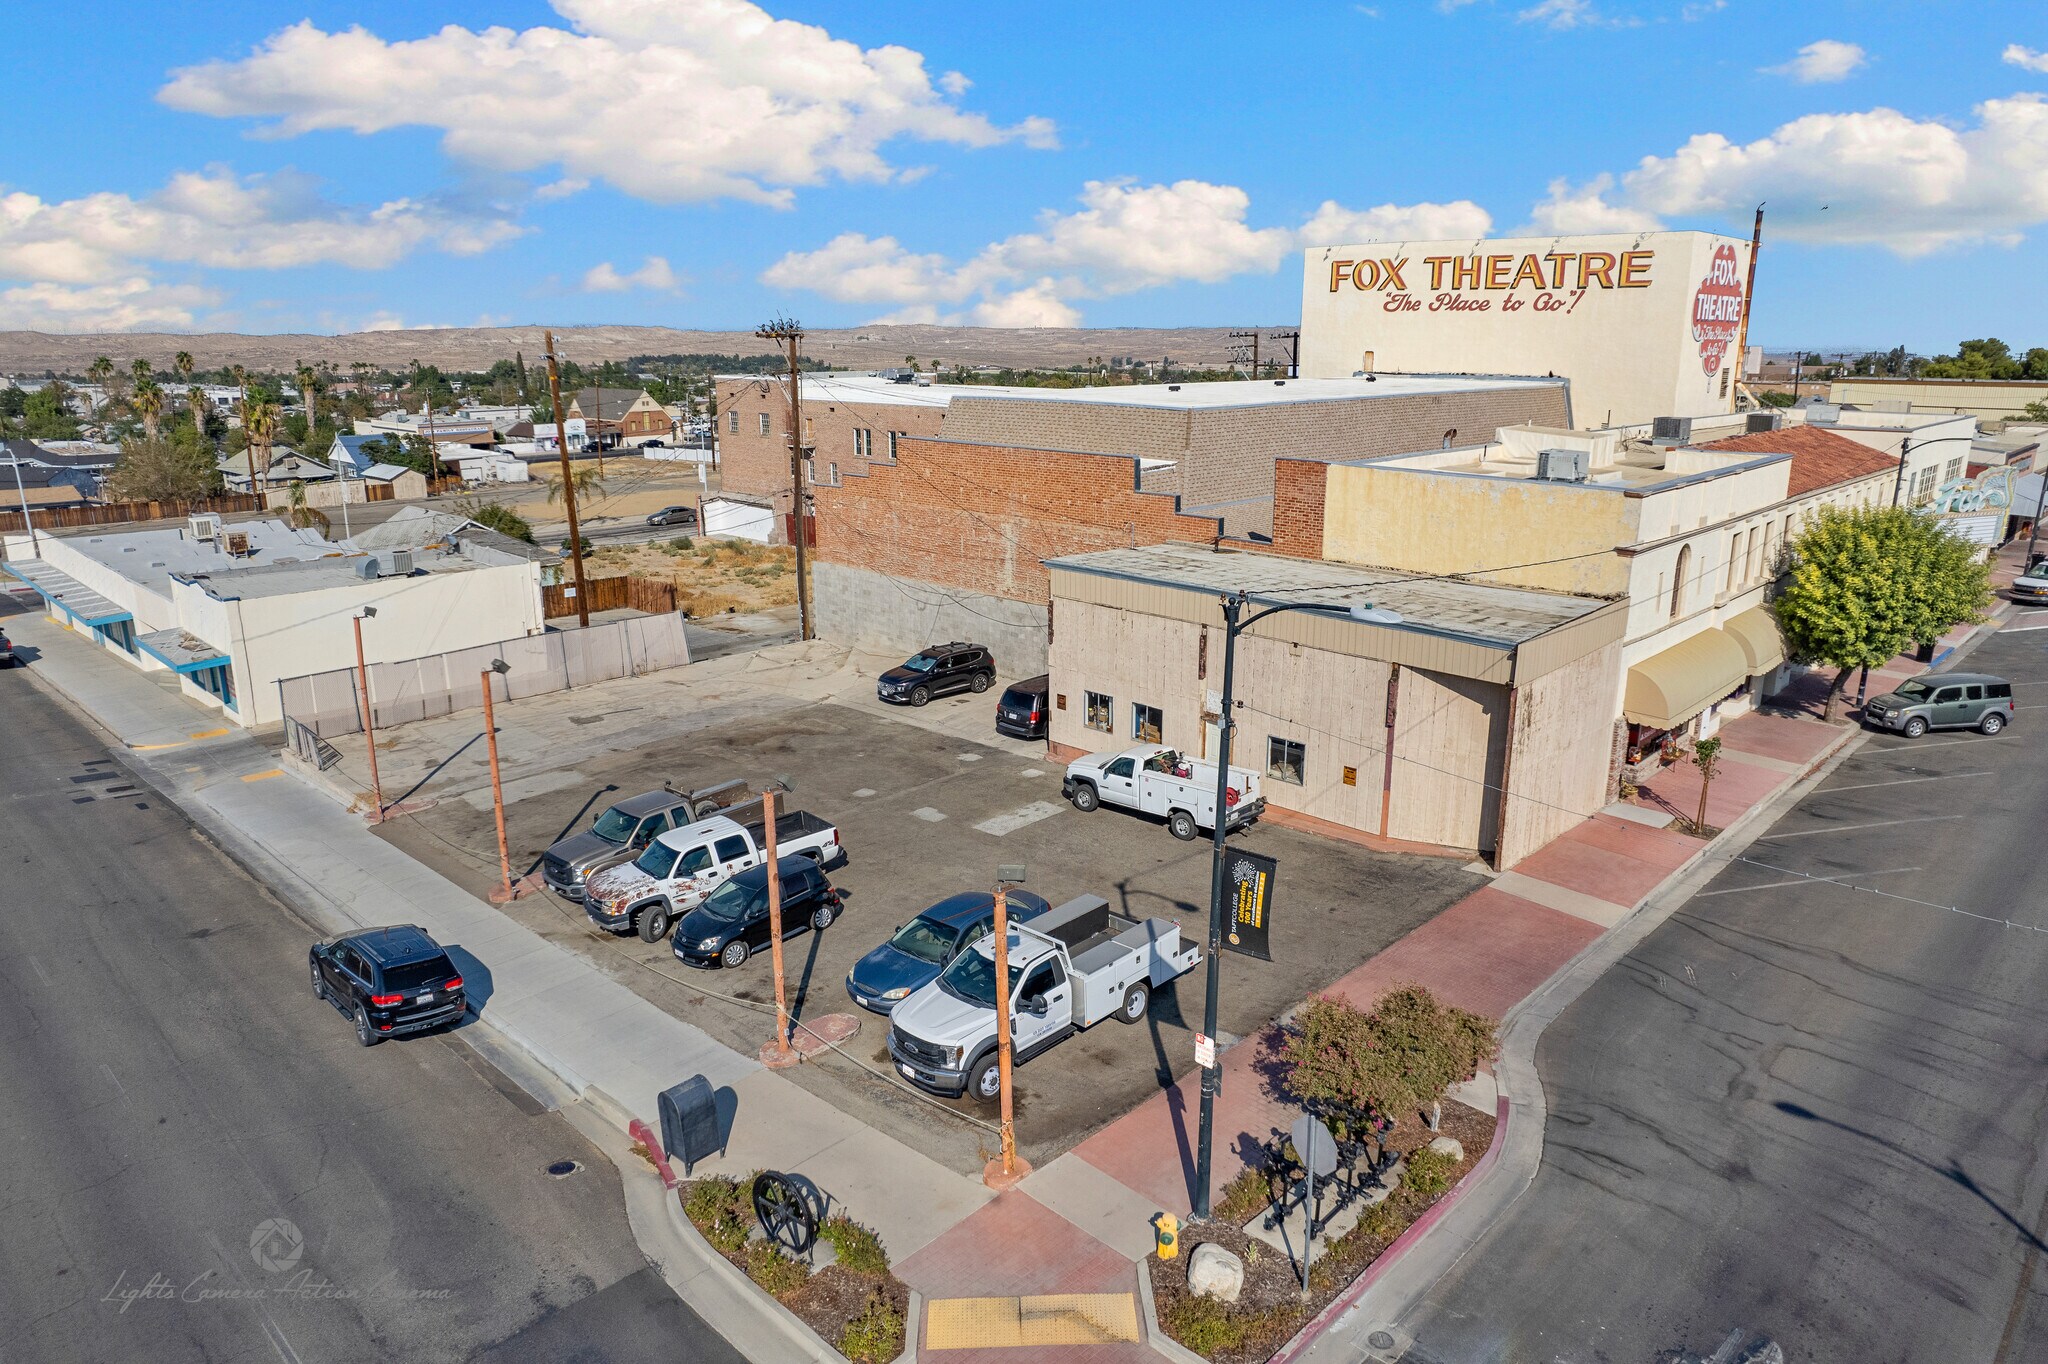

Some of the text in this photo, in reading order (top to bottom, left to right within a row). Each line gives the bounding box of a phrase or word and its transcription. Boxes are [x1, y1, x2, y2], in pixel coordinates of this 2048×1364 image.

[1330, 250, 1655, 292] FOX THEATRE
[1712, 258, 1735, 287] FOX
[1428, 293, 1491, 312] Place
[1501, 292, 1525, 312] to
[1696, 293, 1742, 323] THEATRE
[1238, 880, 1248, 923] Celebrating
[1245, 890, 1253, 911] Years
